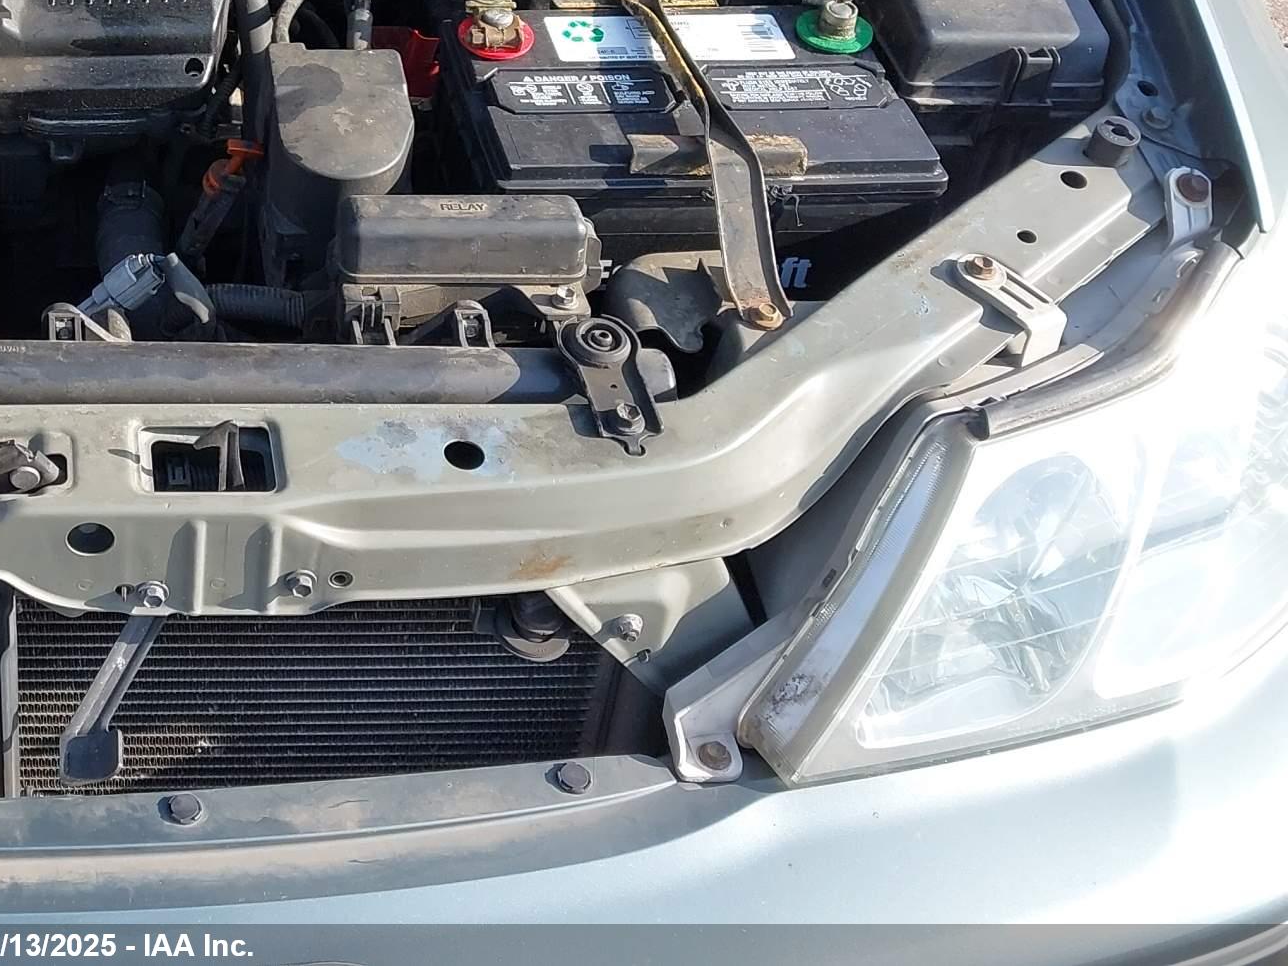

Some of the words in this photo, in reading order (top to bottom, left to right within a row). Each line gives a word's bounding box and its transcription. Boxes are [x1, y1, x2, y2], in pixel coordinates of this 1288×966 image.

[534, 75, 579, 83] DANGER
[589, 74, 630, 82] POISON
[440, 202, 485, 211] RELAY
